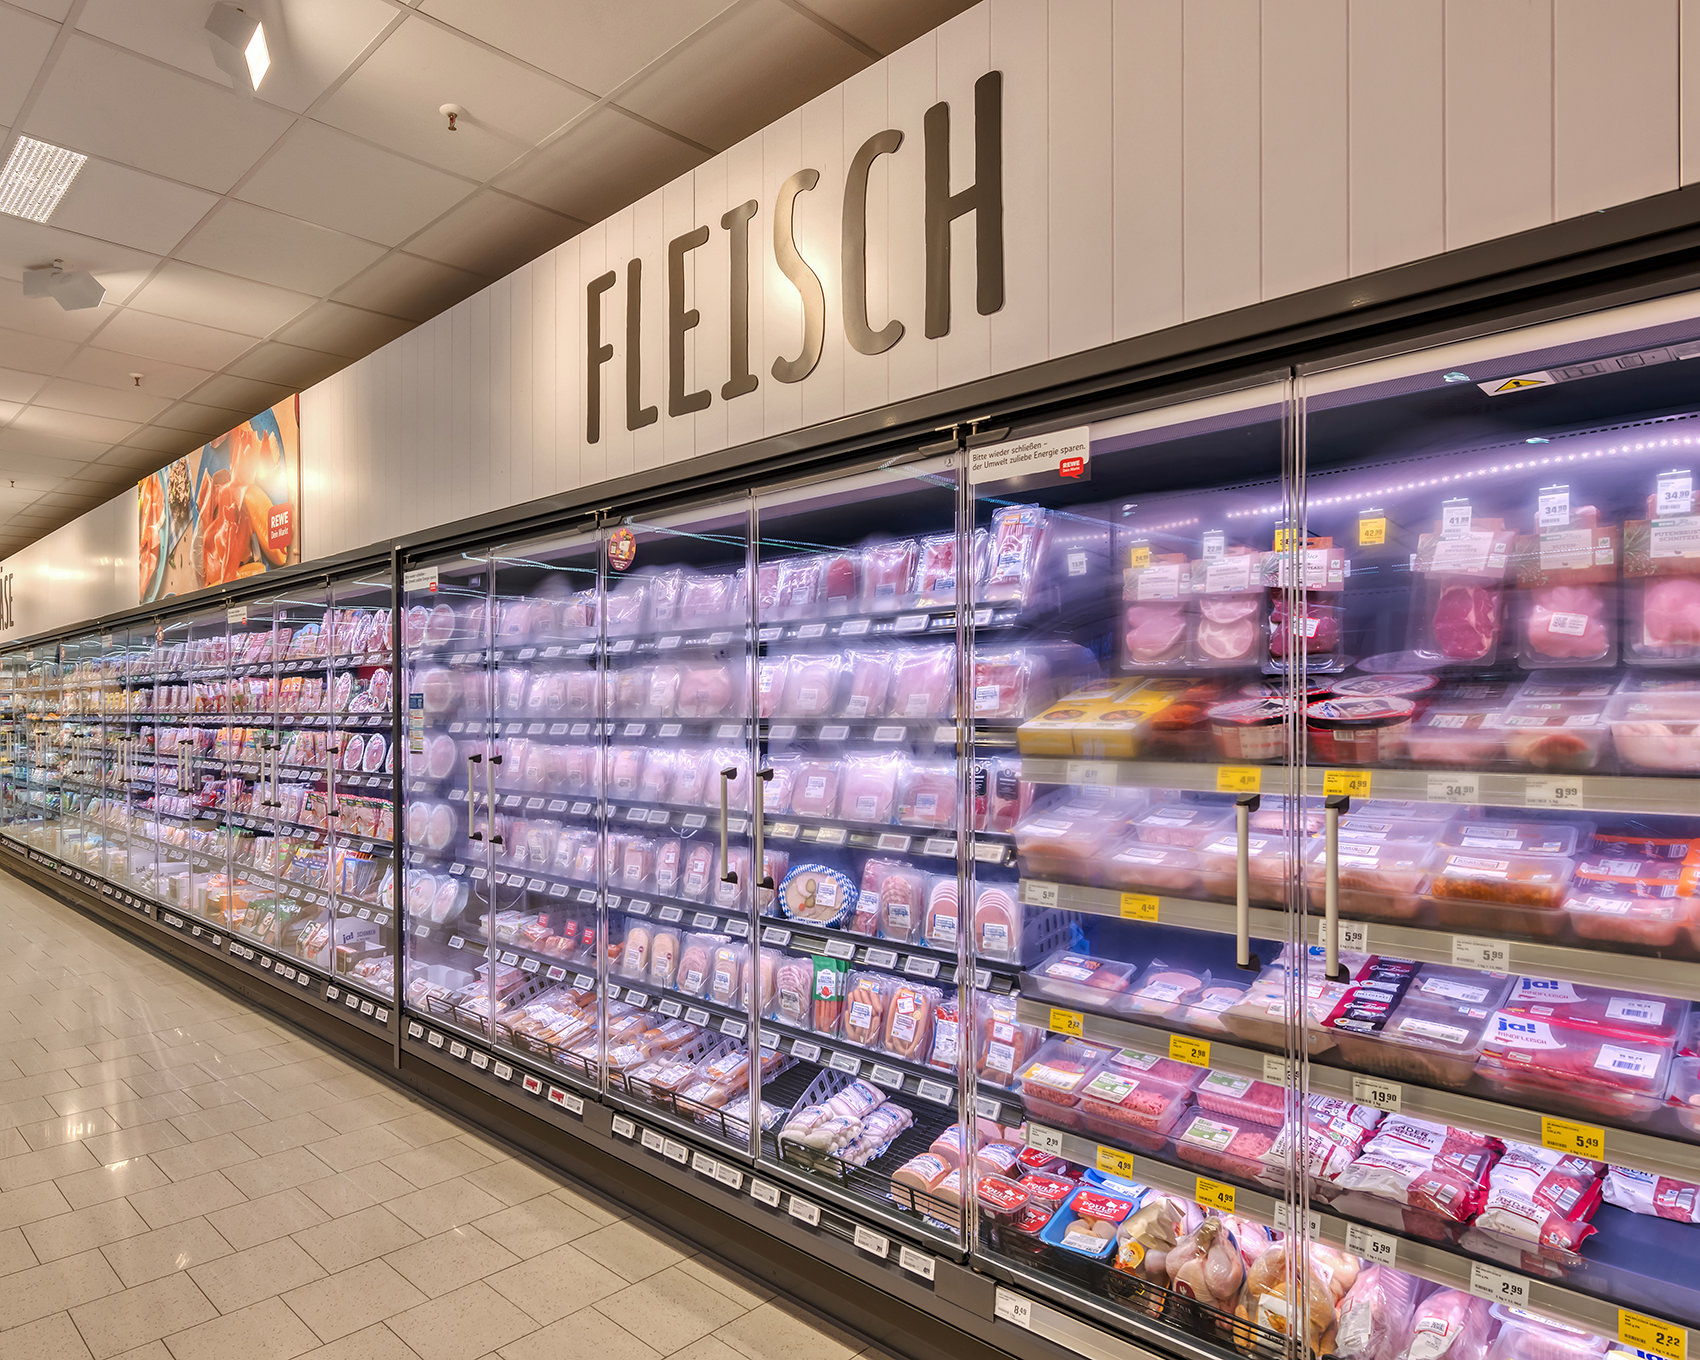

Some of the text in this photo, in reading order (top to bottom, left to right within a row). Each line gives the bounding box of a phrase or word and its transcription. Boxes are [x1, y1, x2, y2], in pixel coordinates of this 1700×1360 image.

[587, 70, 1004, 444] FLEISCH
[972, 453, 987, 462] Bitte
[988, 448, 1010, 458] wieder
[1011, 442, 1042, 454] schließen
[984, 458, 1008, 469] Umwelt
[1010, 453, 1032, 464] zuliebe
[1034, 448, 1059, 460] Energie
[1060, 443, 1086, 455] sparen.
[1062, 460, 1081, 468] REWE
[271, 510, 289, 528] REWE
[271, 527, 289, 540] Dein Markt
[1349, 780, 1368, 790] 4.99
[1446, 786, 1474, 796] 34.90
[1555, 788, 1578, 798] 9.99
[1141, 904, 1155, 912] 4.44
[342, 932, 354, 944] ja!
[1345, 932, 1362, 942] 5.99
[1483, 950, 1504, 962] 5.99
[1522, 978, 1559, 990] ja!
[1522, 990, 1569, 1000] RINDFLEISCH
[1498, 1017, 1536, 1034] ja!
[1498, 1031, 1547, 1045] RINDFLEISCH
[1372, 1090, 1397, 1103] 19.90
[1576, 1136, 1598, 1148] 5.49
[1118, 1160, 1131, 1170] 4.99
[982, 1184, 1015, 1202] POULET
[1026, 1182, 1060, 1194] POULET
[1218, 1192, 1233, 1203] 4.99
[1082, 1201, 1120, 1214] POULET
[1372, 1242, 1390, 1254] 5.99
[1502, 1282, 1523, 1296] 2.99
[1656, 1332, 1680, 1347] 2.22
